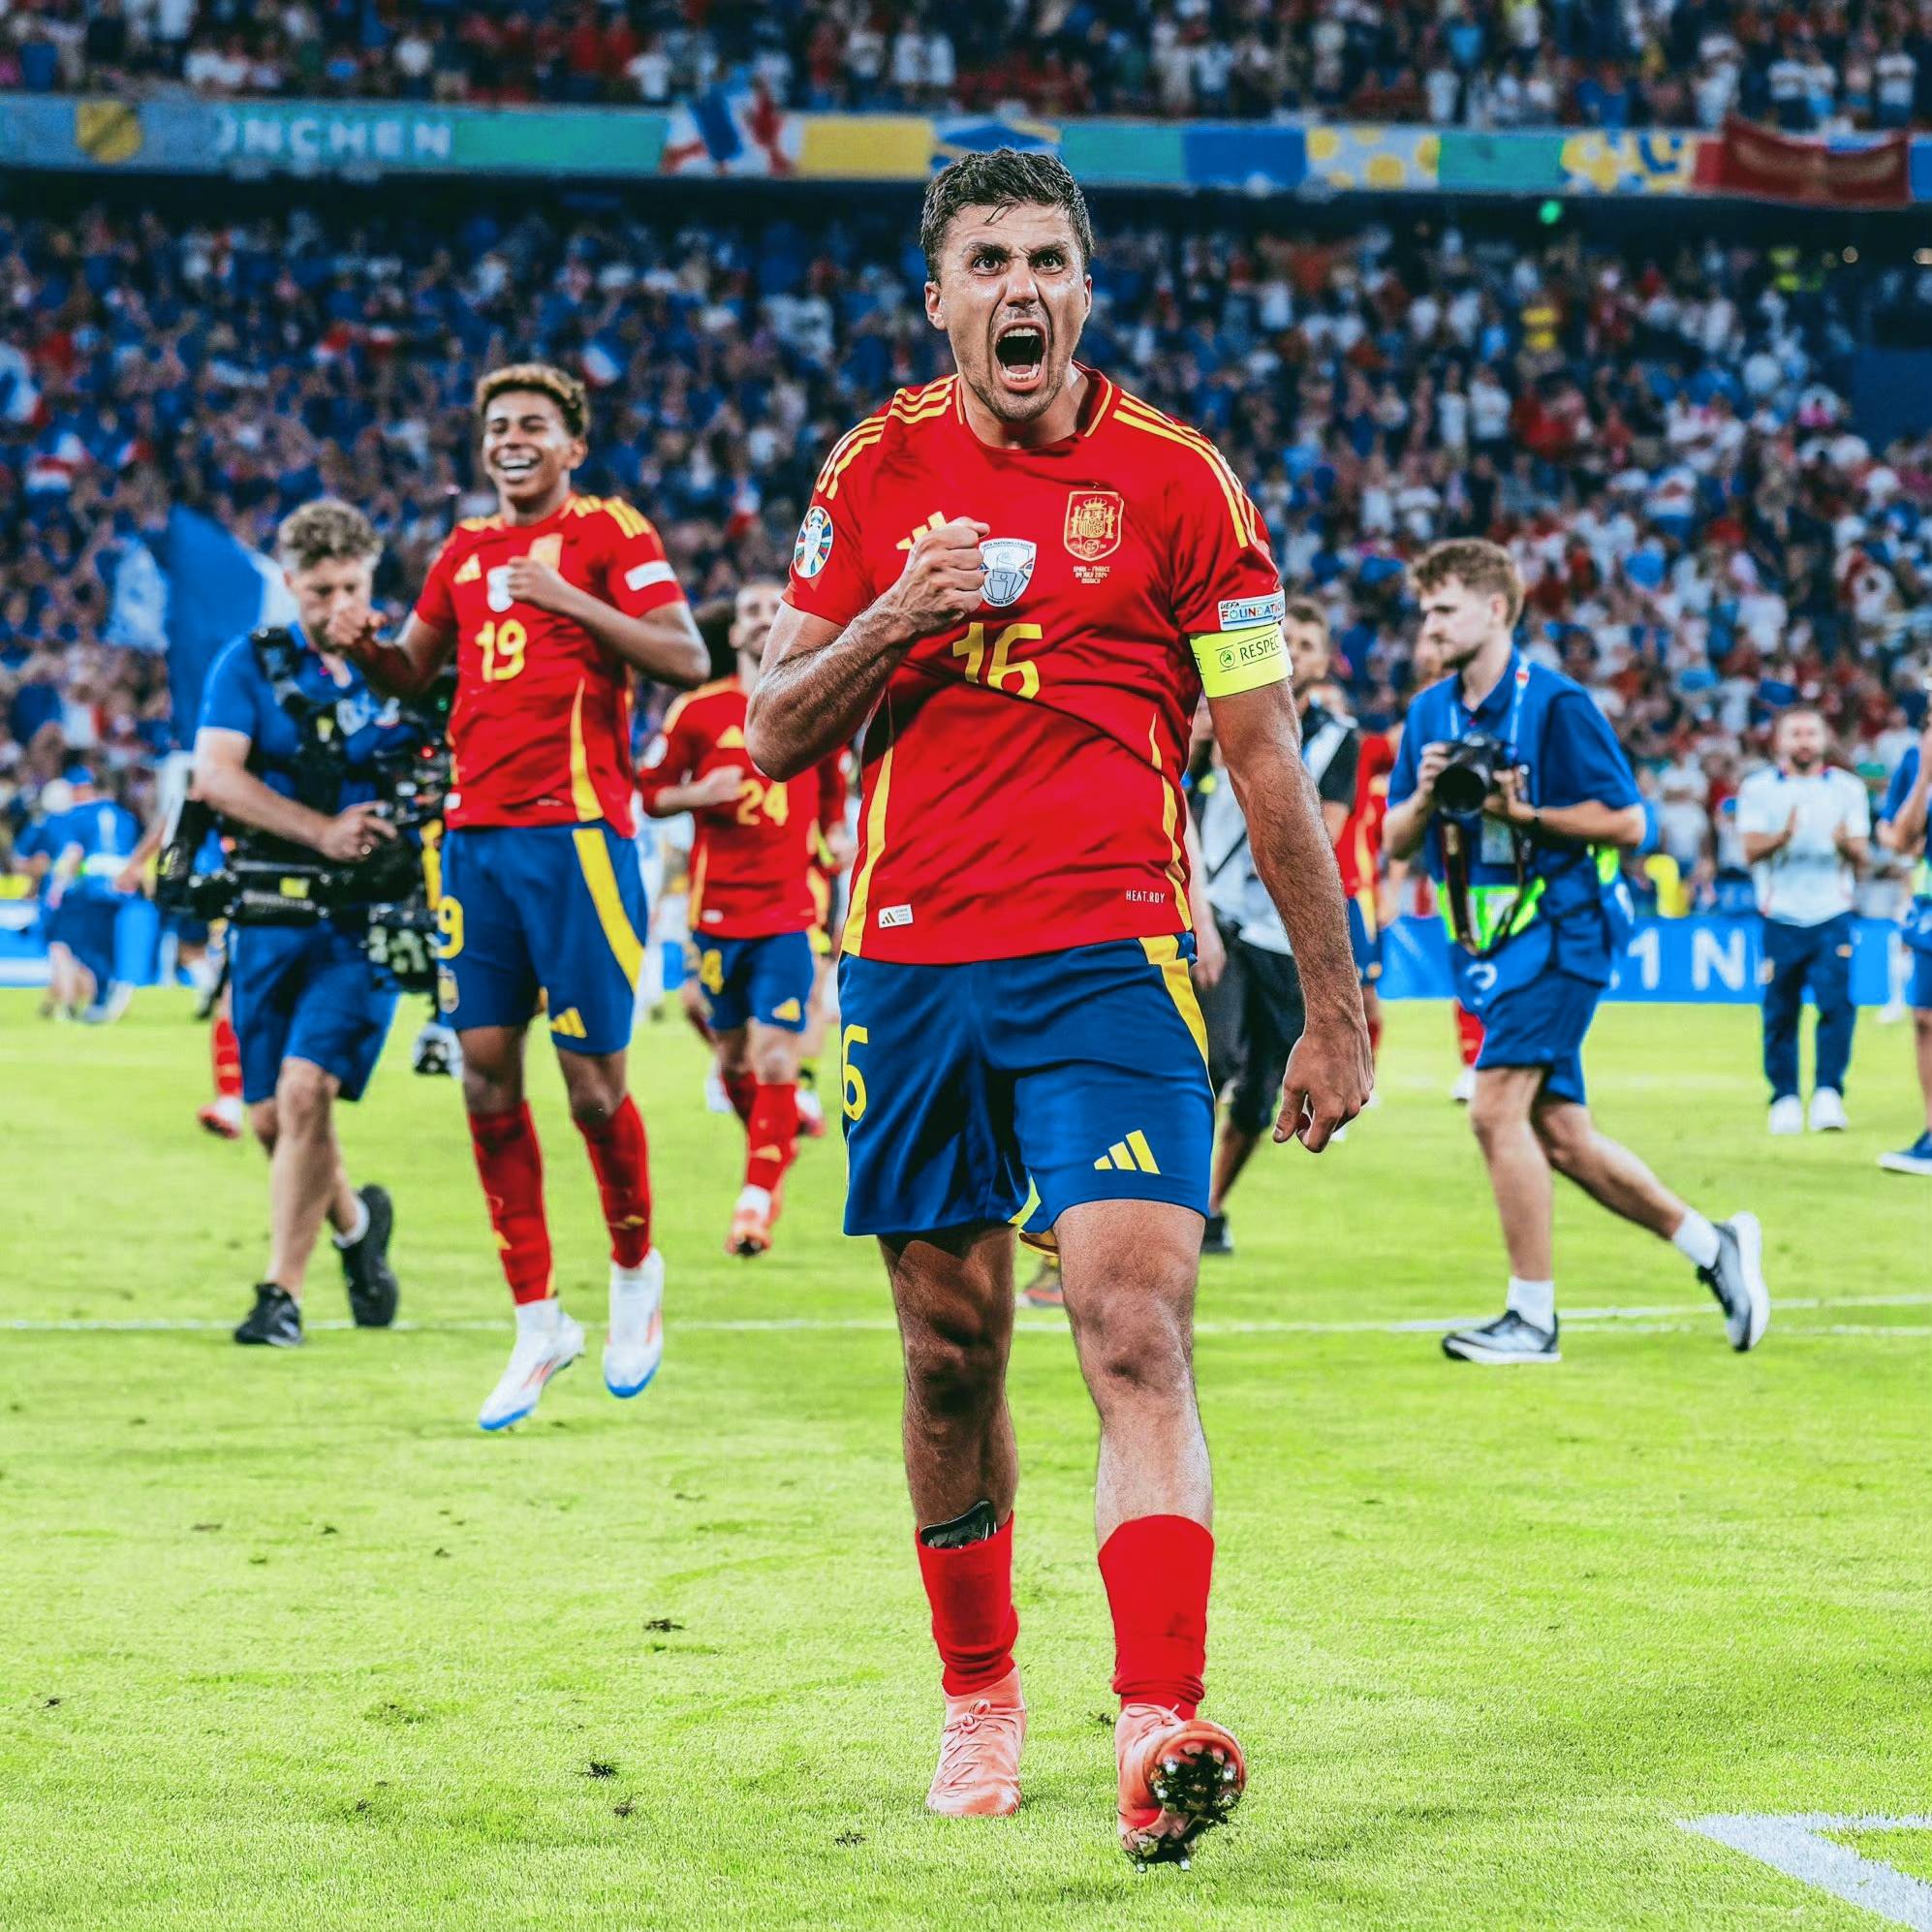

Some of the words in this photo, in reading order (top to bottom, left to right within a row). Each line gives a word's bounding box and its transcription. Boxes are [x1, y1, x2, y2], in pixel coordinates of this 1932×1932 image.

[475, 619, 527, 682] 19
[952, 622, 1043, 700] 16
[736, 779, 790, 827] 24
[437, 894, 465, 959] 9
[1126, 889, 1166, 904] HEAT.RDY
[842, 1023, 869, 1121] 6
